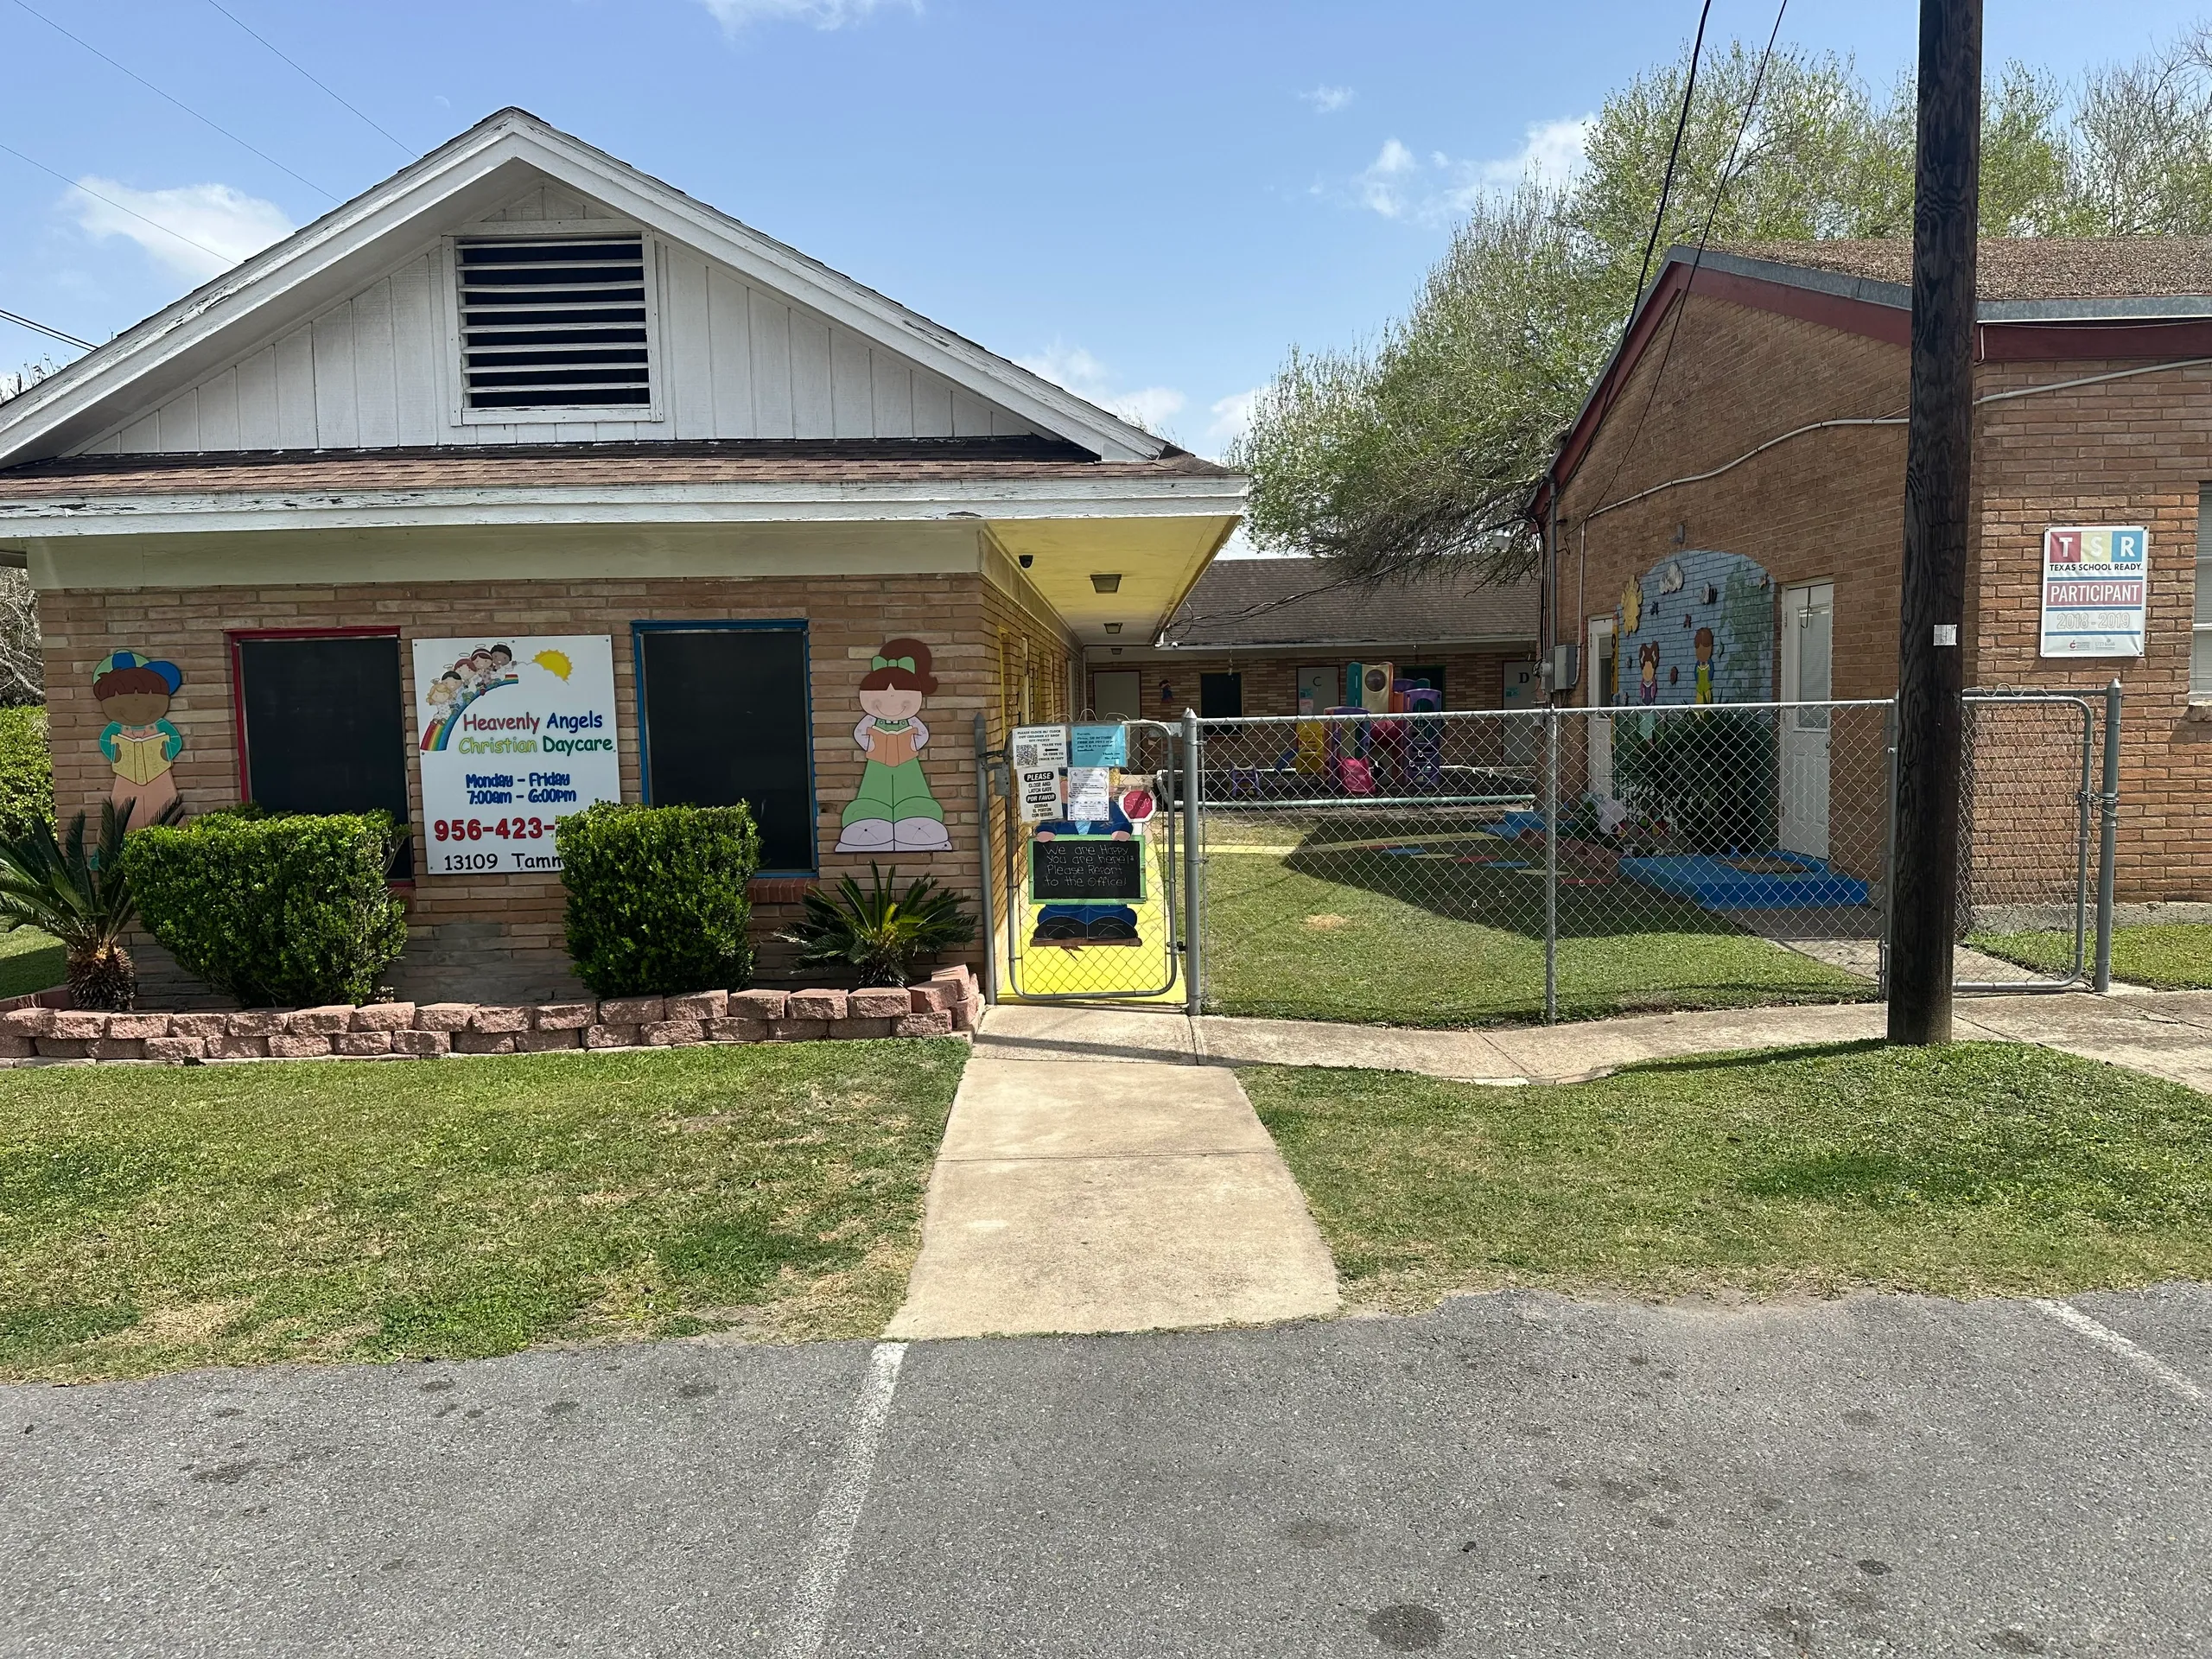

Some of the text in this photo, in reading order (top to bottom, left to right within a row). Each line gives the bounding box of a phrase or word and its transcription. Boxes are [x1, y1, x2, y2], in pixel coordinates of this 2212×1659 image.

[2050, 584, 2140, 602] PARTICIPANT
[2056, 613, 2088, 629] 2018
[2098, 613, 2130, 629] 2019
[1313, 677, 1322, 686] C
[1518, 672, 1529, 683] D
[463, 709, 603, 734] Heavenly Angels
[459, 735, 613, 757] Christian Daycare
[466, 773, 513, 788] Monday
[529, 772, 570, 787] Friday
[1027, 772, 1051, 781] PLEASE
[467, 790, 512, 804] 7:00am
[1126, 798, 1150, 811] STOP
[434, 817, 560, 842] 956-423-
[1042, 844, 1128, 855] We are Happy
[444, 853, 498, 871] 13109
[1046, 855, 1067, 864] you
[1071, 855, 1093, 864] are
[1046, 864, 1122, 874] Please Report
[1045, 875, 1059, 887] to
[1065, 875, 1084, 887] the
